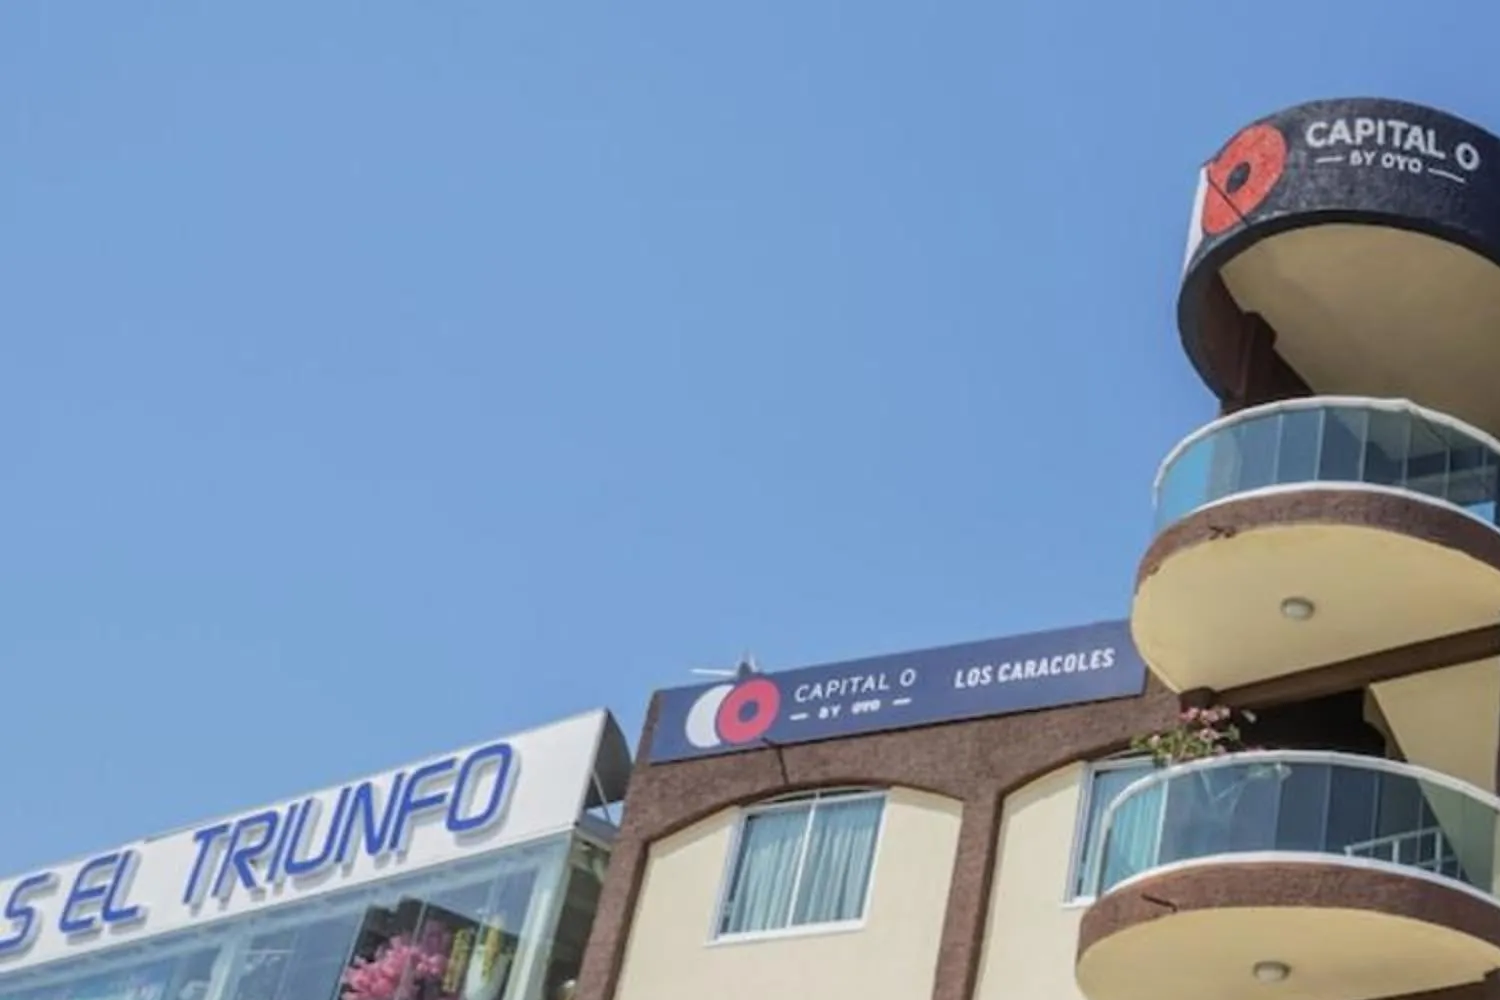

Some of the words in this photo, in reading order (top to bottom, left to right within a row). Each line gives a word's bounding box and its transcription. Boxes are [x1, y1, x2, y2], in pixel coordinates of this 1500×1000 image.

[1305, 118, 1445, 159] CAPITAL
[1455, 143, 1480, 171] O
[1349, 151, 1375, 166] BY
[1381, 152, 1423, 174] OYO
[794, 672, 890, 703] CAPITAL
[900, 668, 916, 688] O
[955, 662, 992, 689] LOS
[997, 648, 1116, 683] CARACOLES
[818, 704, 841, 720] BY
[58, 850, 139, 932] EL
[182, 743, 513, 904] TRIUNFO
